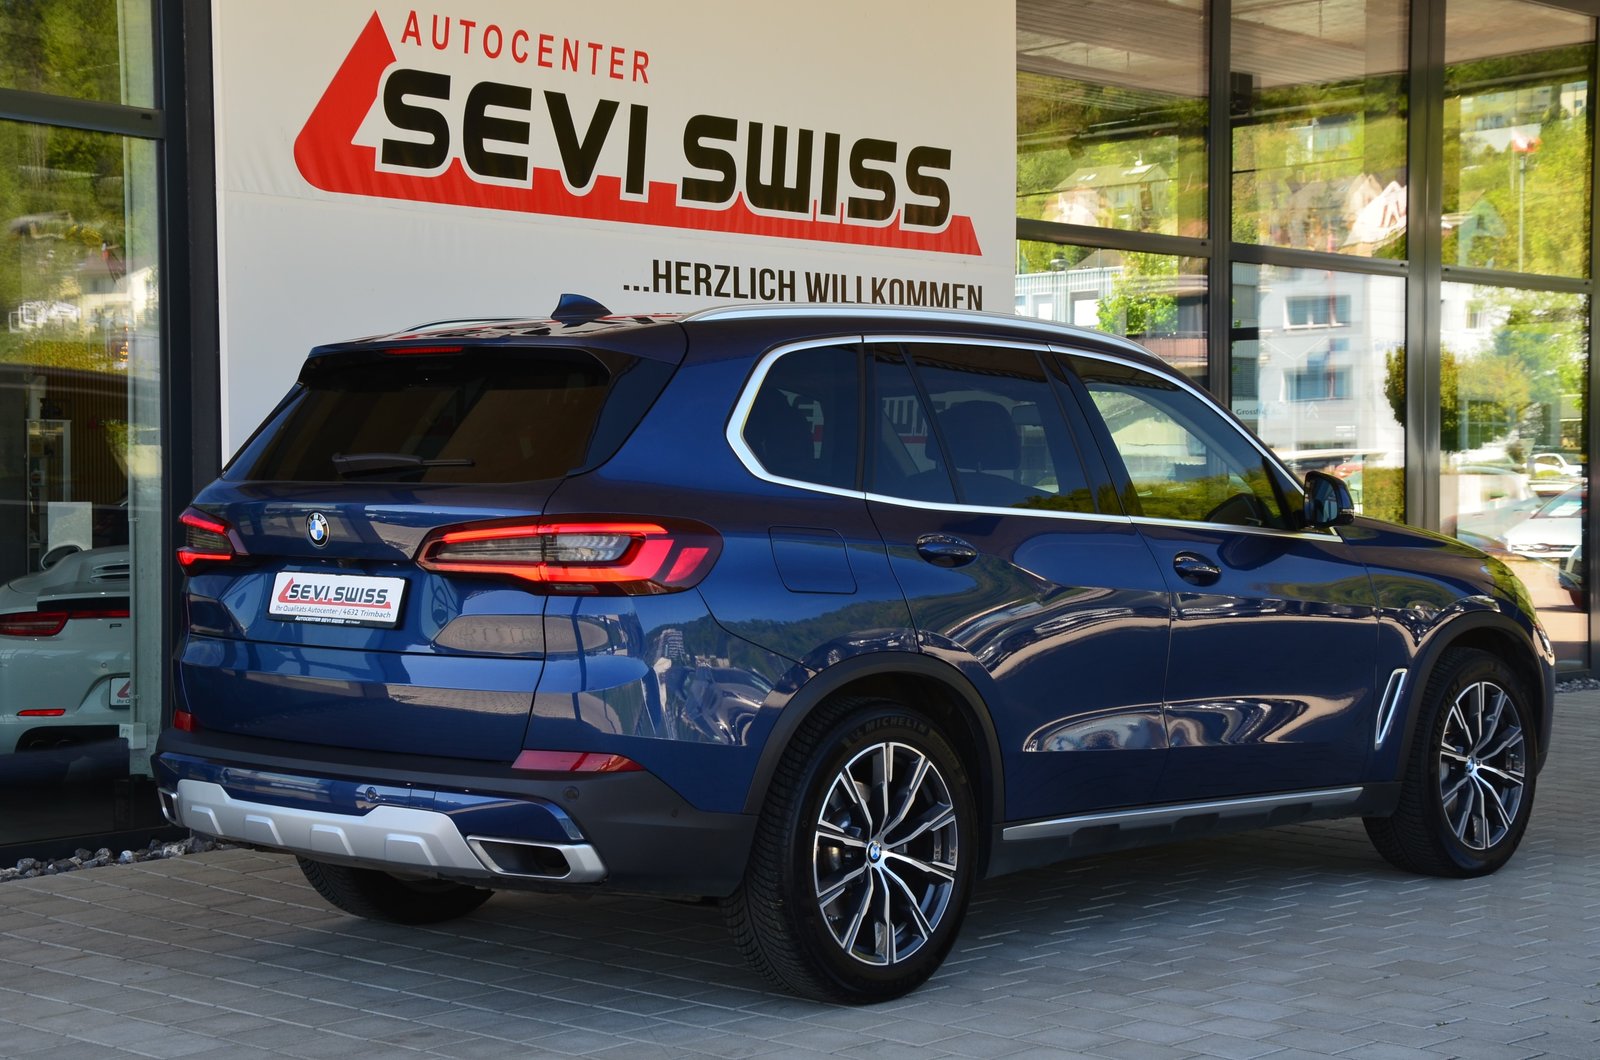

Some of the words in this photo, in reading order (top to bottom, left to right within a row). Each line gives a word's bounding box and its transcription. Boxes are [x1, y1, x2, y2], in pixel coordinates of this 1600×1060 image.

[400, 9, 650, 84] AUTOCENTER
[381, 68, 649, 195] SEVI
[680, 114, 953, 228] SWISS
[805, 271, 983, 311] WILLKOMMEN
[289, 584, 330, 600] SEVI
[333, 586, 388, 604] SWISS
[308, 606, 338, 616] Autocenter
[342, 608, 359, 617] 4632
[360, 610, 391, 619] Trimbach
[864, 715, 928, 734] MICHELIN
